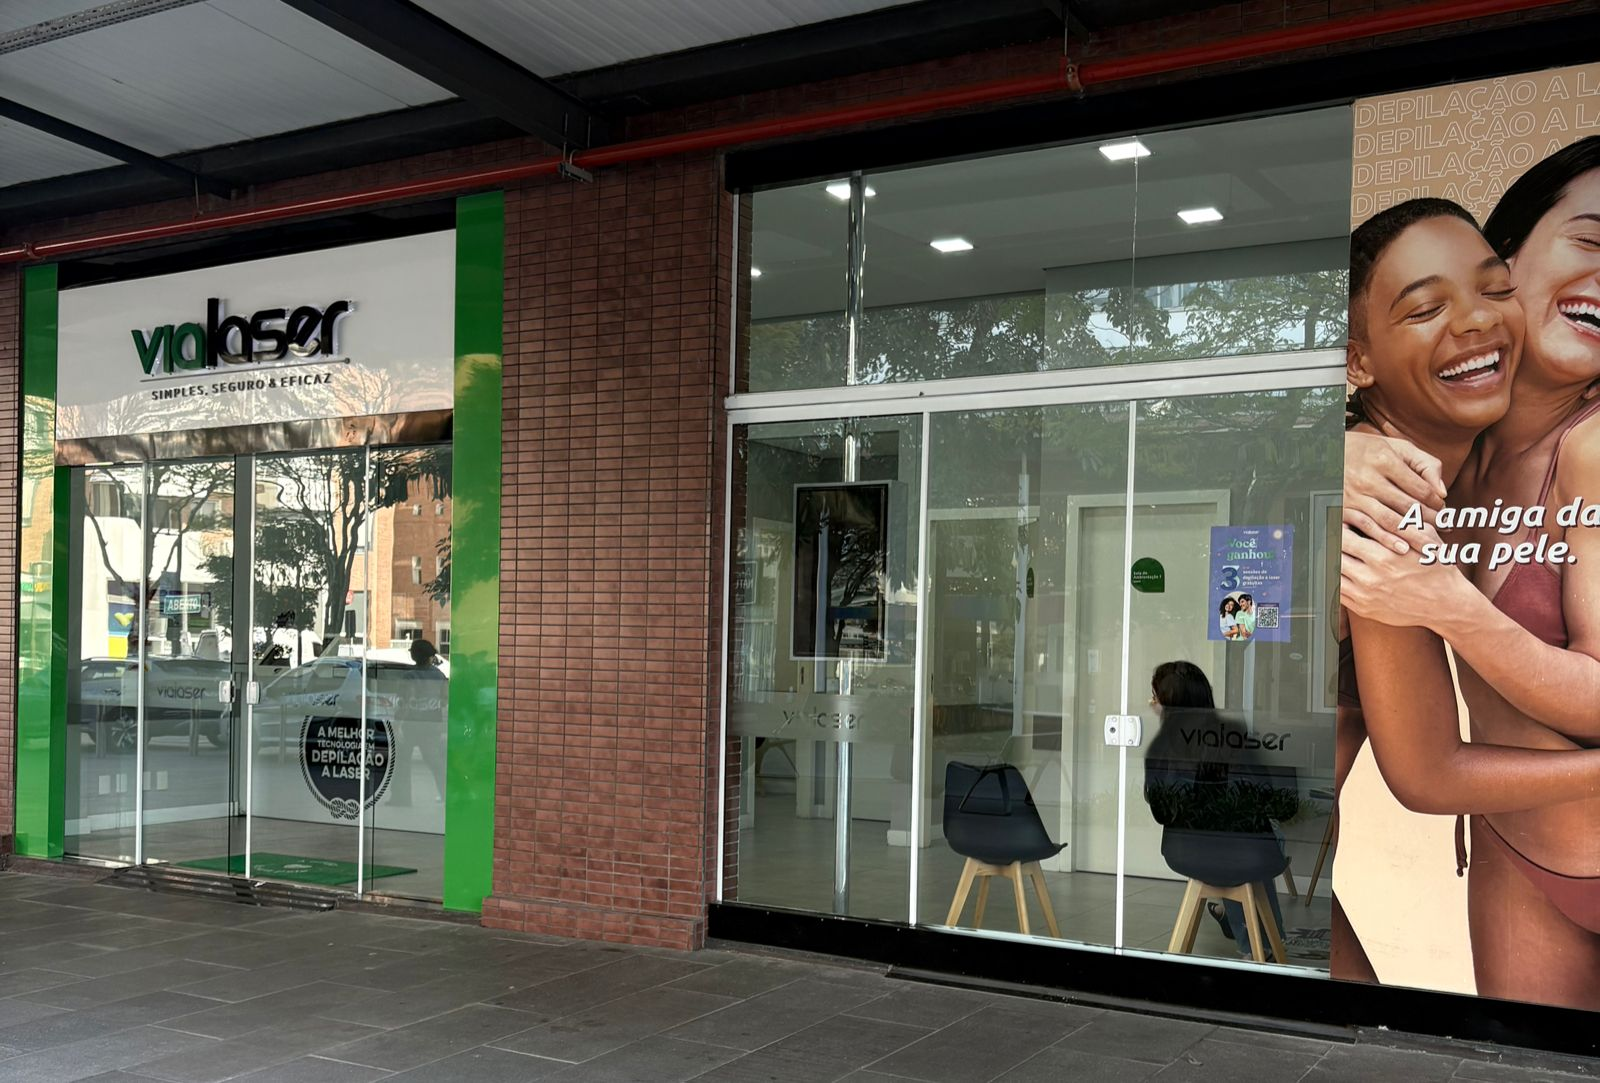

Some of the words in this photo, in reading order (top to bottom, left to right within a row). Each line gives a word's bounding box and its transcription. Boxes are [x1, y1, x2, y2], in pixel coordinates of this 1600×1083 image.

[1355, 78, 1537, 128] DEPILAÇÃO
[1543, 76, 1569, 102] A
[1577, 72, 1600, 97] L
[1354, 108, 1535, 158] DEPILAÇÃO
[1541, 107, 1568, 133] A
[1576, 104, 1600, 129] L
[1353, 138, 1534, 188] DEPILAÇÃO
[1352, 169, 1523, 217] DEPILAÇÃ
[131, 298, 350, 375] vialaser
[151, 385, 208, 400] SIMPLES,
[212, 380, 264, 394] SEGURO
[268, 378, 277, 389] &
[280, 373, 332, 387] EFICAZ
[1398, 503, 1424, 530] A
[1435, 499, 1546, 534] amiga
[1556, 496, 1600, 527] da
[1419, 542, 1481, 564] sua
[1488, 534, 1578, 570] pele.
[1220, 565, 1240, 590] 3
[317, 726, 326, 738] A
[1180, 723, 1291, 751] vialaser
[321, 764, 330, 777] A
[333, 765, 370, 780] LASER
